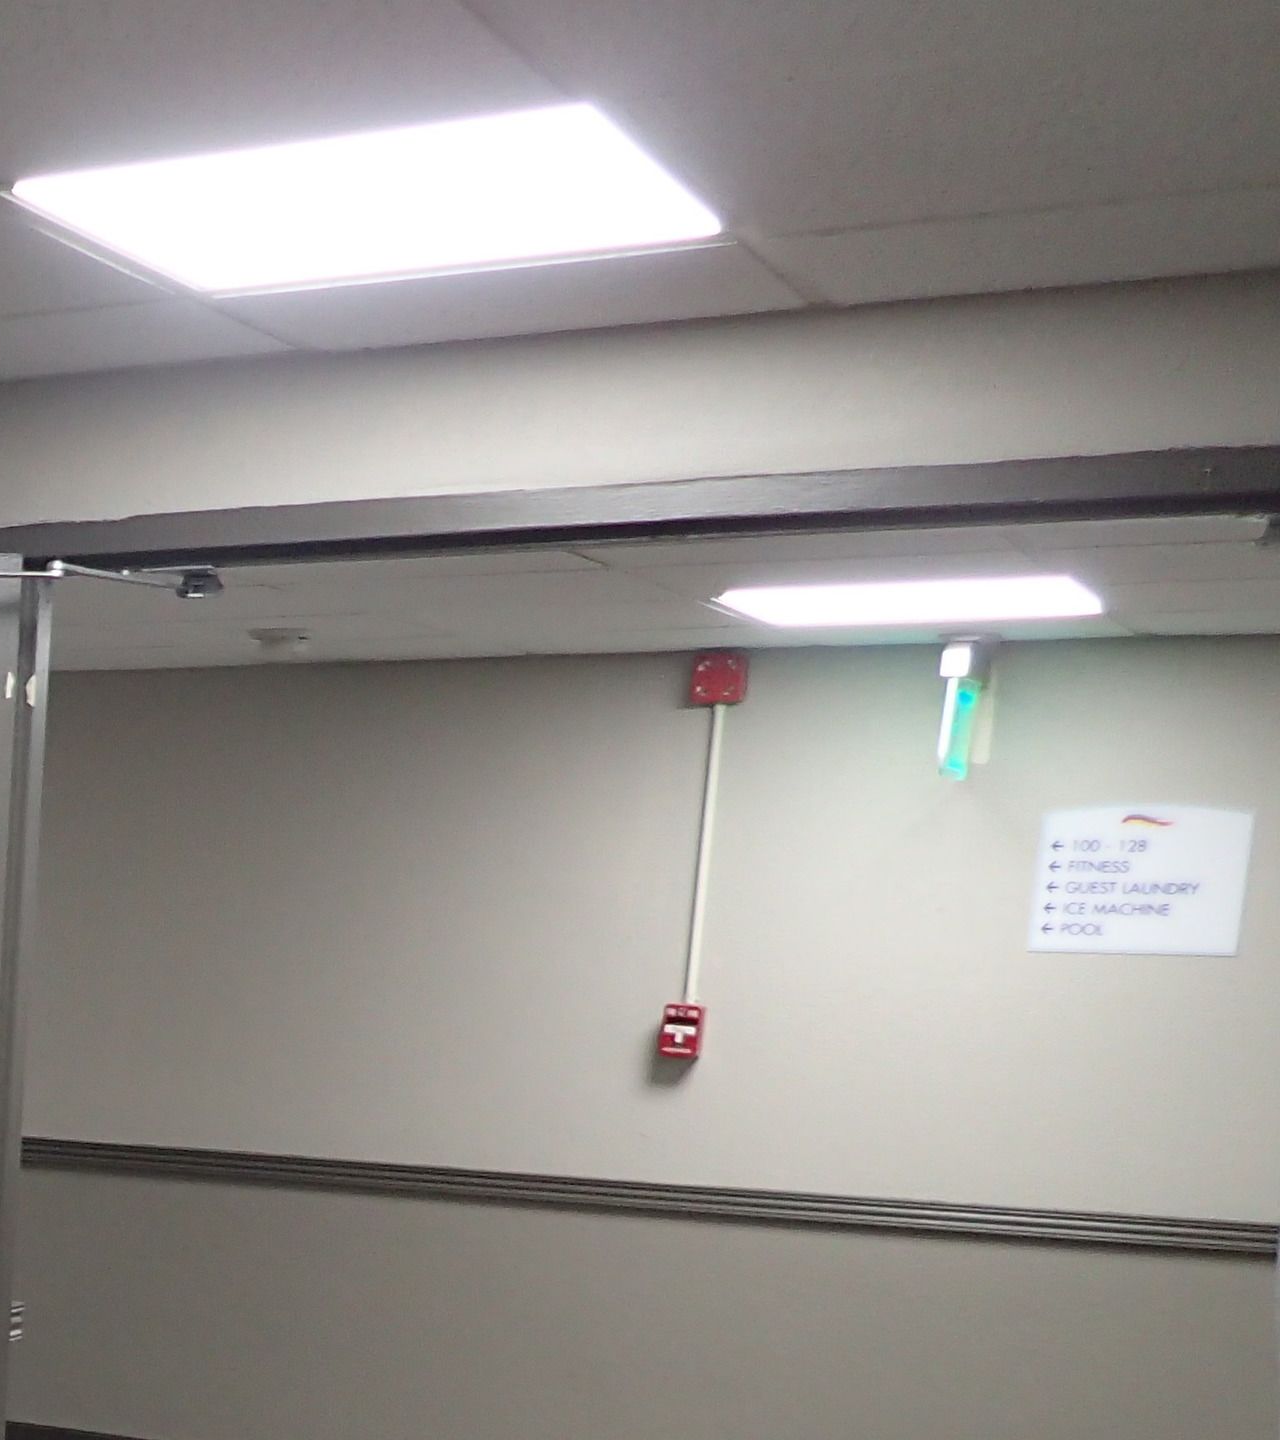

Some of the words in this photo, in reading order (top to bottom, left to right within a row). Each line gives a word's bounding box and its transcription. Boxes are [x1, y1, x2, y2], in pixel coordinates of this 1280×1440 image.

[1067, 860, 1131, 874] FITNESS
[1065, 881, 1117, 895] GUEST
[1122, 882, 1201, 896] LAUNDRY
[1062, 902, 1087, 916] ICE
[1090, 902, 1171, 917] MACHINE
[1059, 922, 1104, 937] POOL
